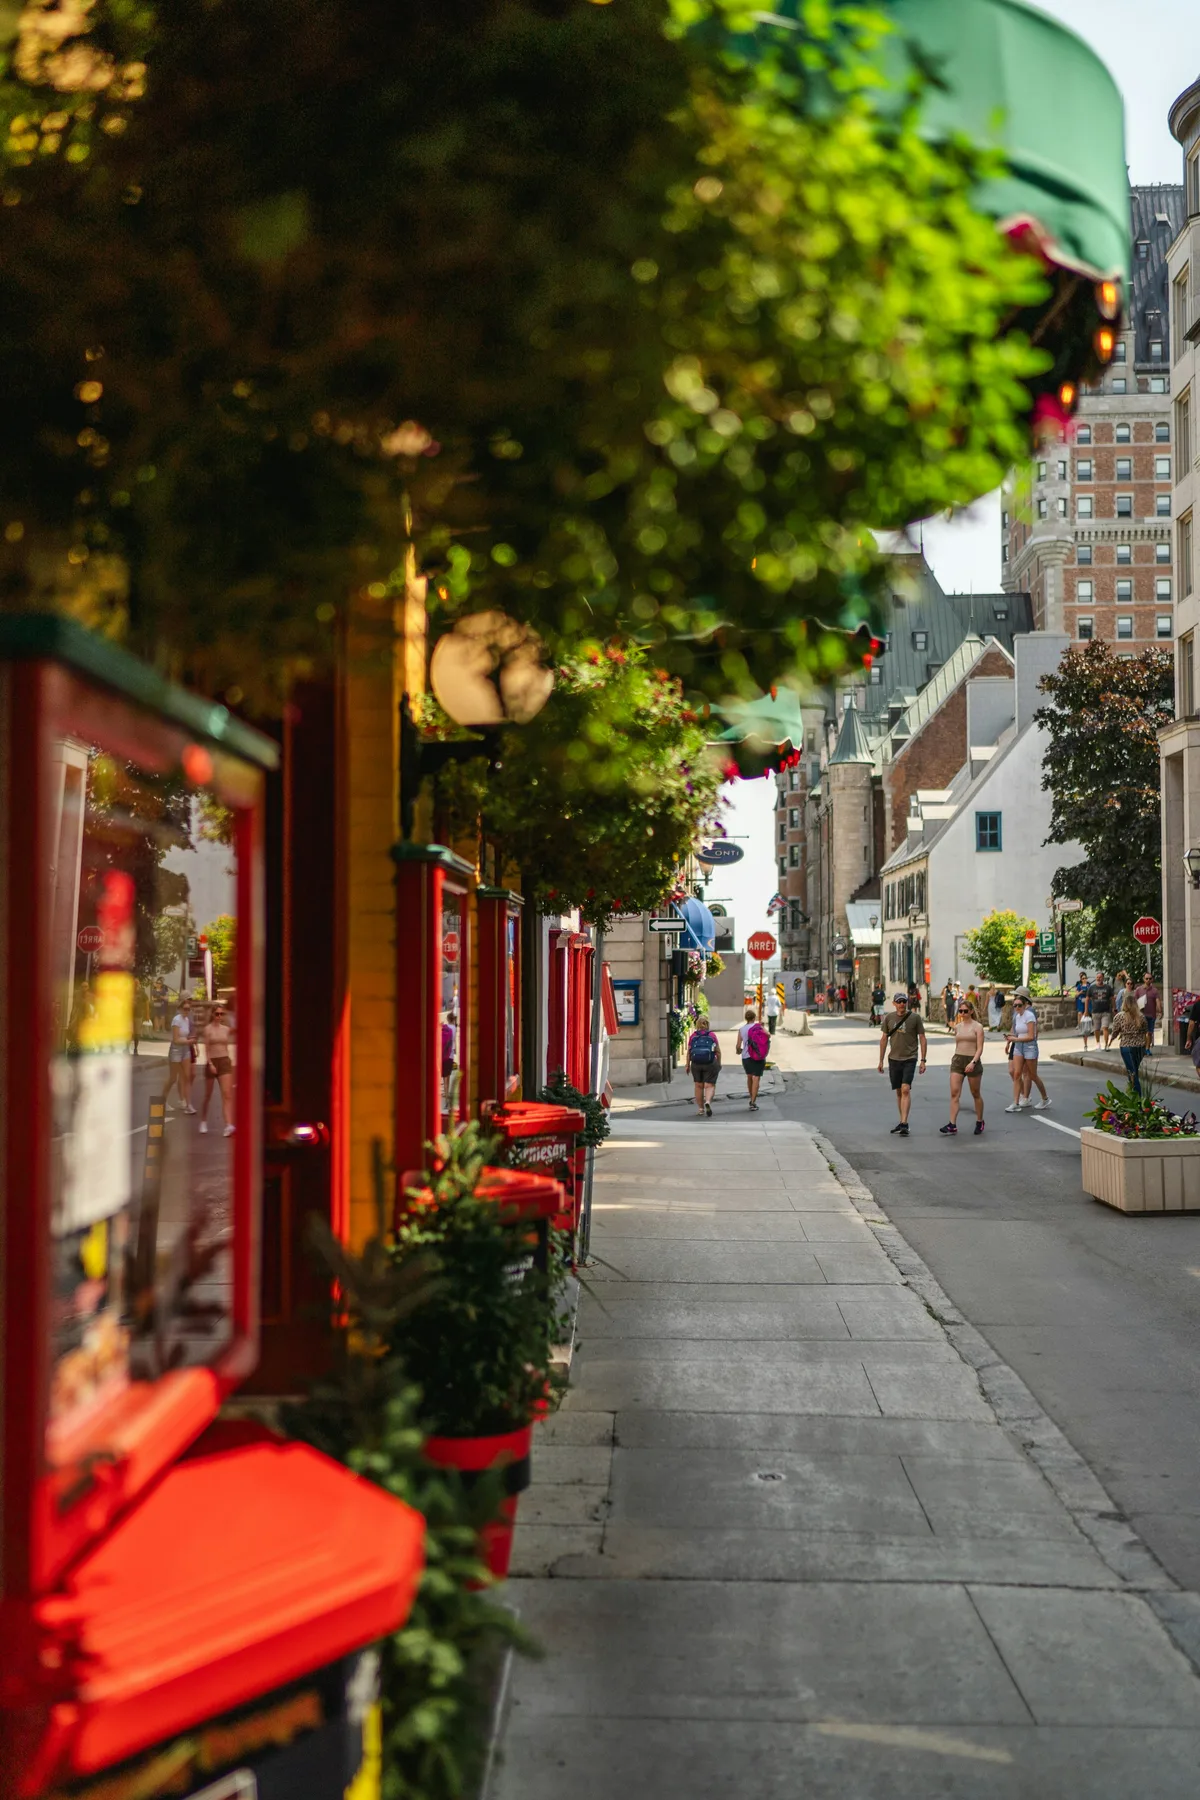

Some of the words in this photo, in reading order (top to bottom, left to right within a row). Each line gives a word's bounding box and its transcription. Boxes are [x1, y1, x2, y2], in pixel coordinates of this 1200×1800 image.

[701, 848, 739, 859] CONTI
[1135, 925, 1159, 935] ARRÊT
[1042, 934, 1053, 945] P
[748, 941, 776, 951] ARRÊT
